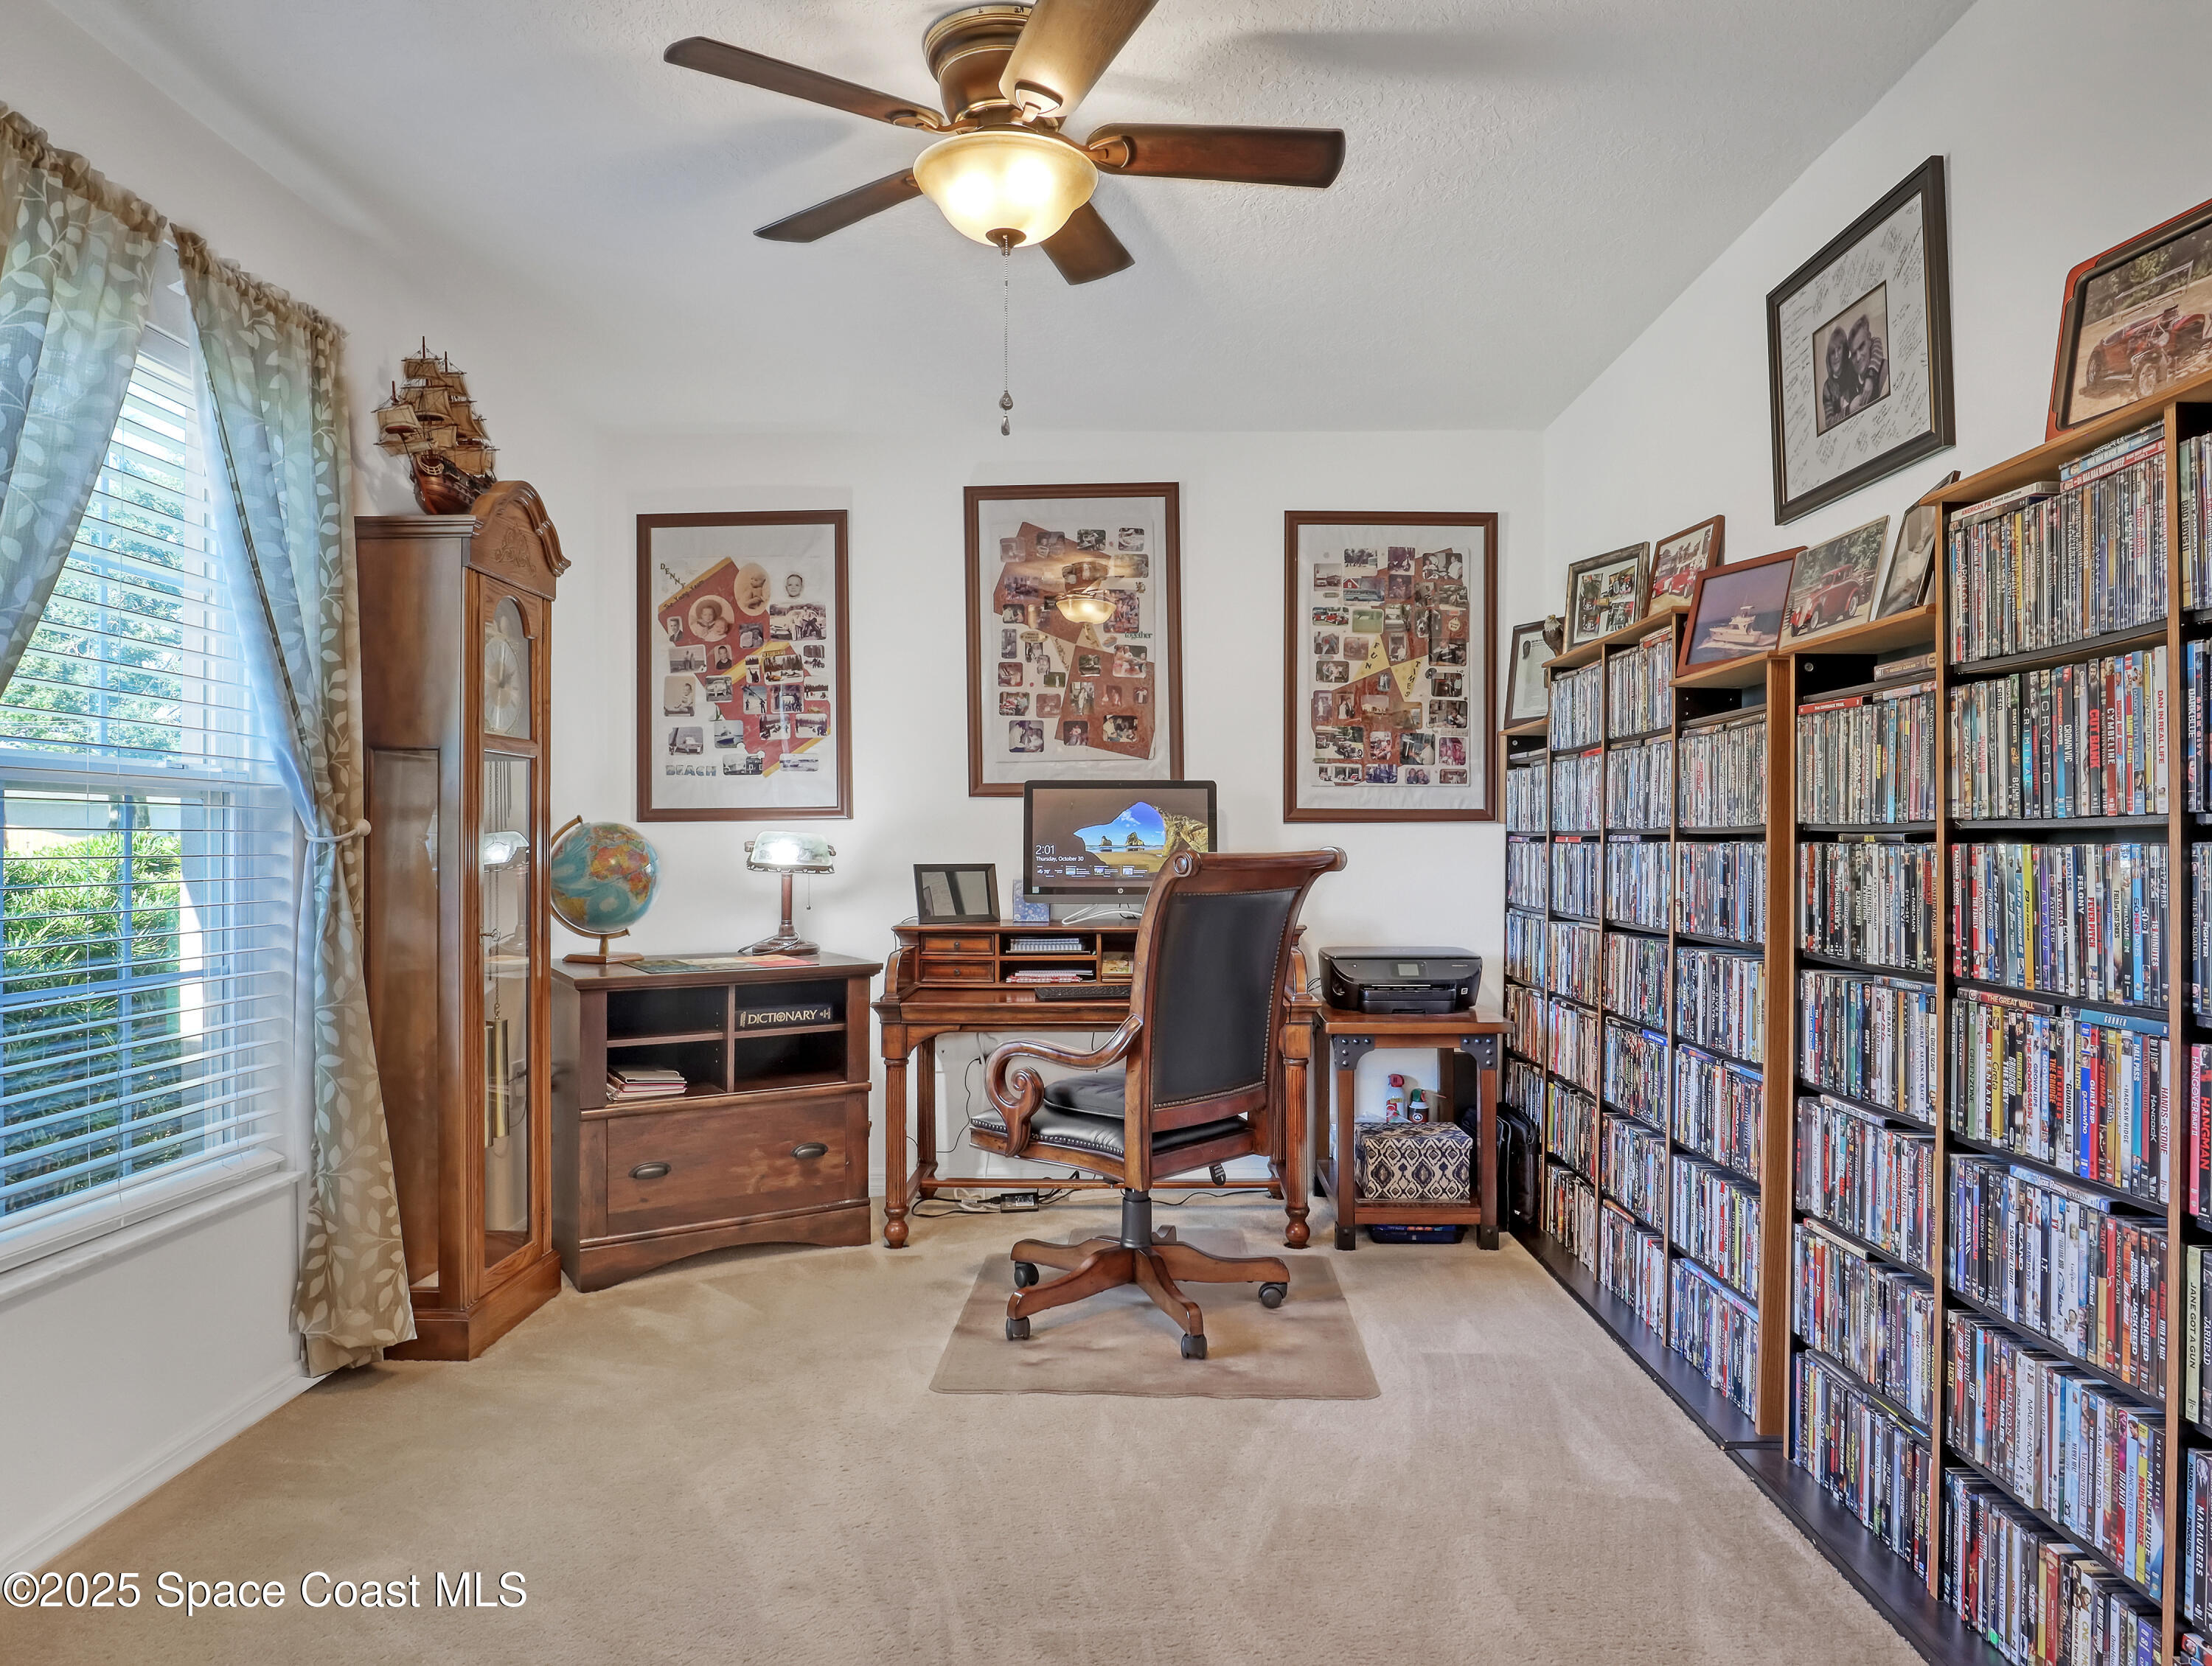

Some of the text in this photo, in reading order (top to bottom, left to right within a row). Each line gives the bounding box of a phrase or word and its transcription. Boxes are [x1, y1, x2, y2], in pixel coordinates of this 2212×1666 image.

[1961, 503, 1983, 515] AMERICAN
[660, 563, 686, 589] DENNY
[1124, 631, 1152, 640] together
[1365, 642, 1380, 669] FUN
[1404, 661, 1421, 697] TIMES
[2157, 711, 2163, 719] IN
[2041, 700, 2051, 784] CRYPTO
[2064, 724, 2073, 763] CROWN VIC
[2107, 708, 2115, 764] CYMBELINE
[1035, 845, 1054, 855] 2:01
[2025, 890, 2030, 902] F9
[2151, 930, 2160, 967] MINUTES
[1896, 980, 1921, 993] GREYHOUND
[748, 1009, 818, 1025] DICTIONARY
[1986, 994, 2035, 1011] THE GREAT WALL
[2104, 1014, 2127, 1027] GUNNER
[1985, 1042, 1993, 1112] GREENLAND
[1992, 1062, 2000, 1090] Greta
[2065, 1084, 2073, 1125] GUARDIAN
[2191, 1056, 2200, 1129] HANGOVER PART
[2149, 1094, 2157, 1143] HANCOCK
[2160, 1126, 2168, 1156] STONE
[2199, 1096, 2211, 1171] HANGMAN
[2041, 1257, 2049, 1274] I.T.
[2188, 1282, 2197, 1310] JANE
[2188, 1313, 2197, 1334] GOT
[2203, 1315, 2212, 1366] JARHEAD
[1947, 1360, 1955, 1390] LUCKY
[2006, 1374, 2014, 1438] MADISON
[2154, 1463, 2160, 1474] OF
[2137, 1510, 2145, 1547] HOUSE
[2195, 1504, 2205, 1577] MARAUDERS
